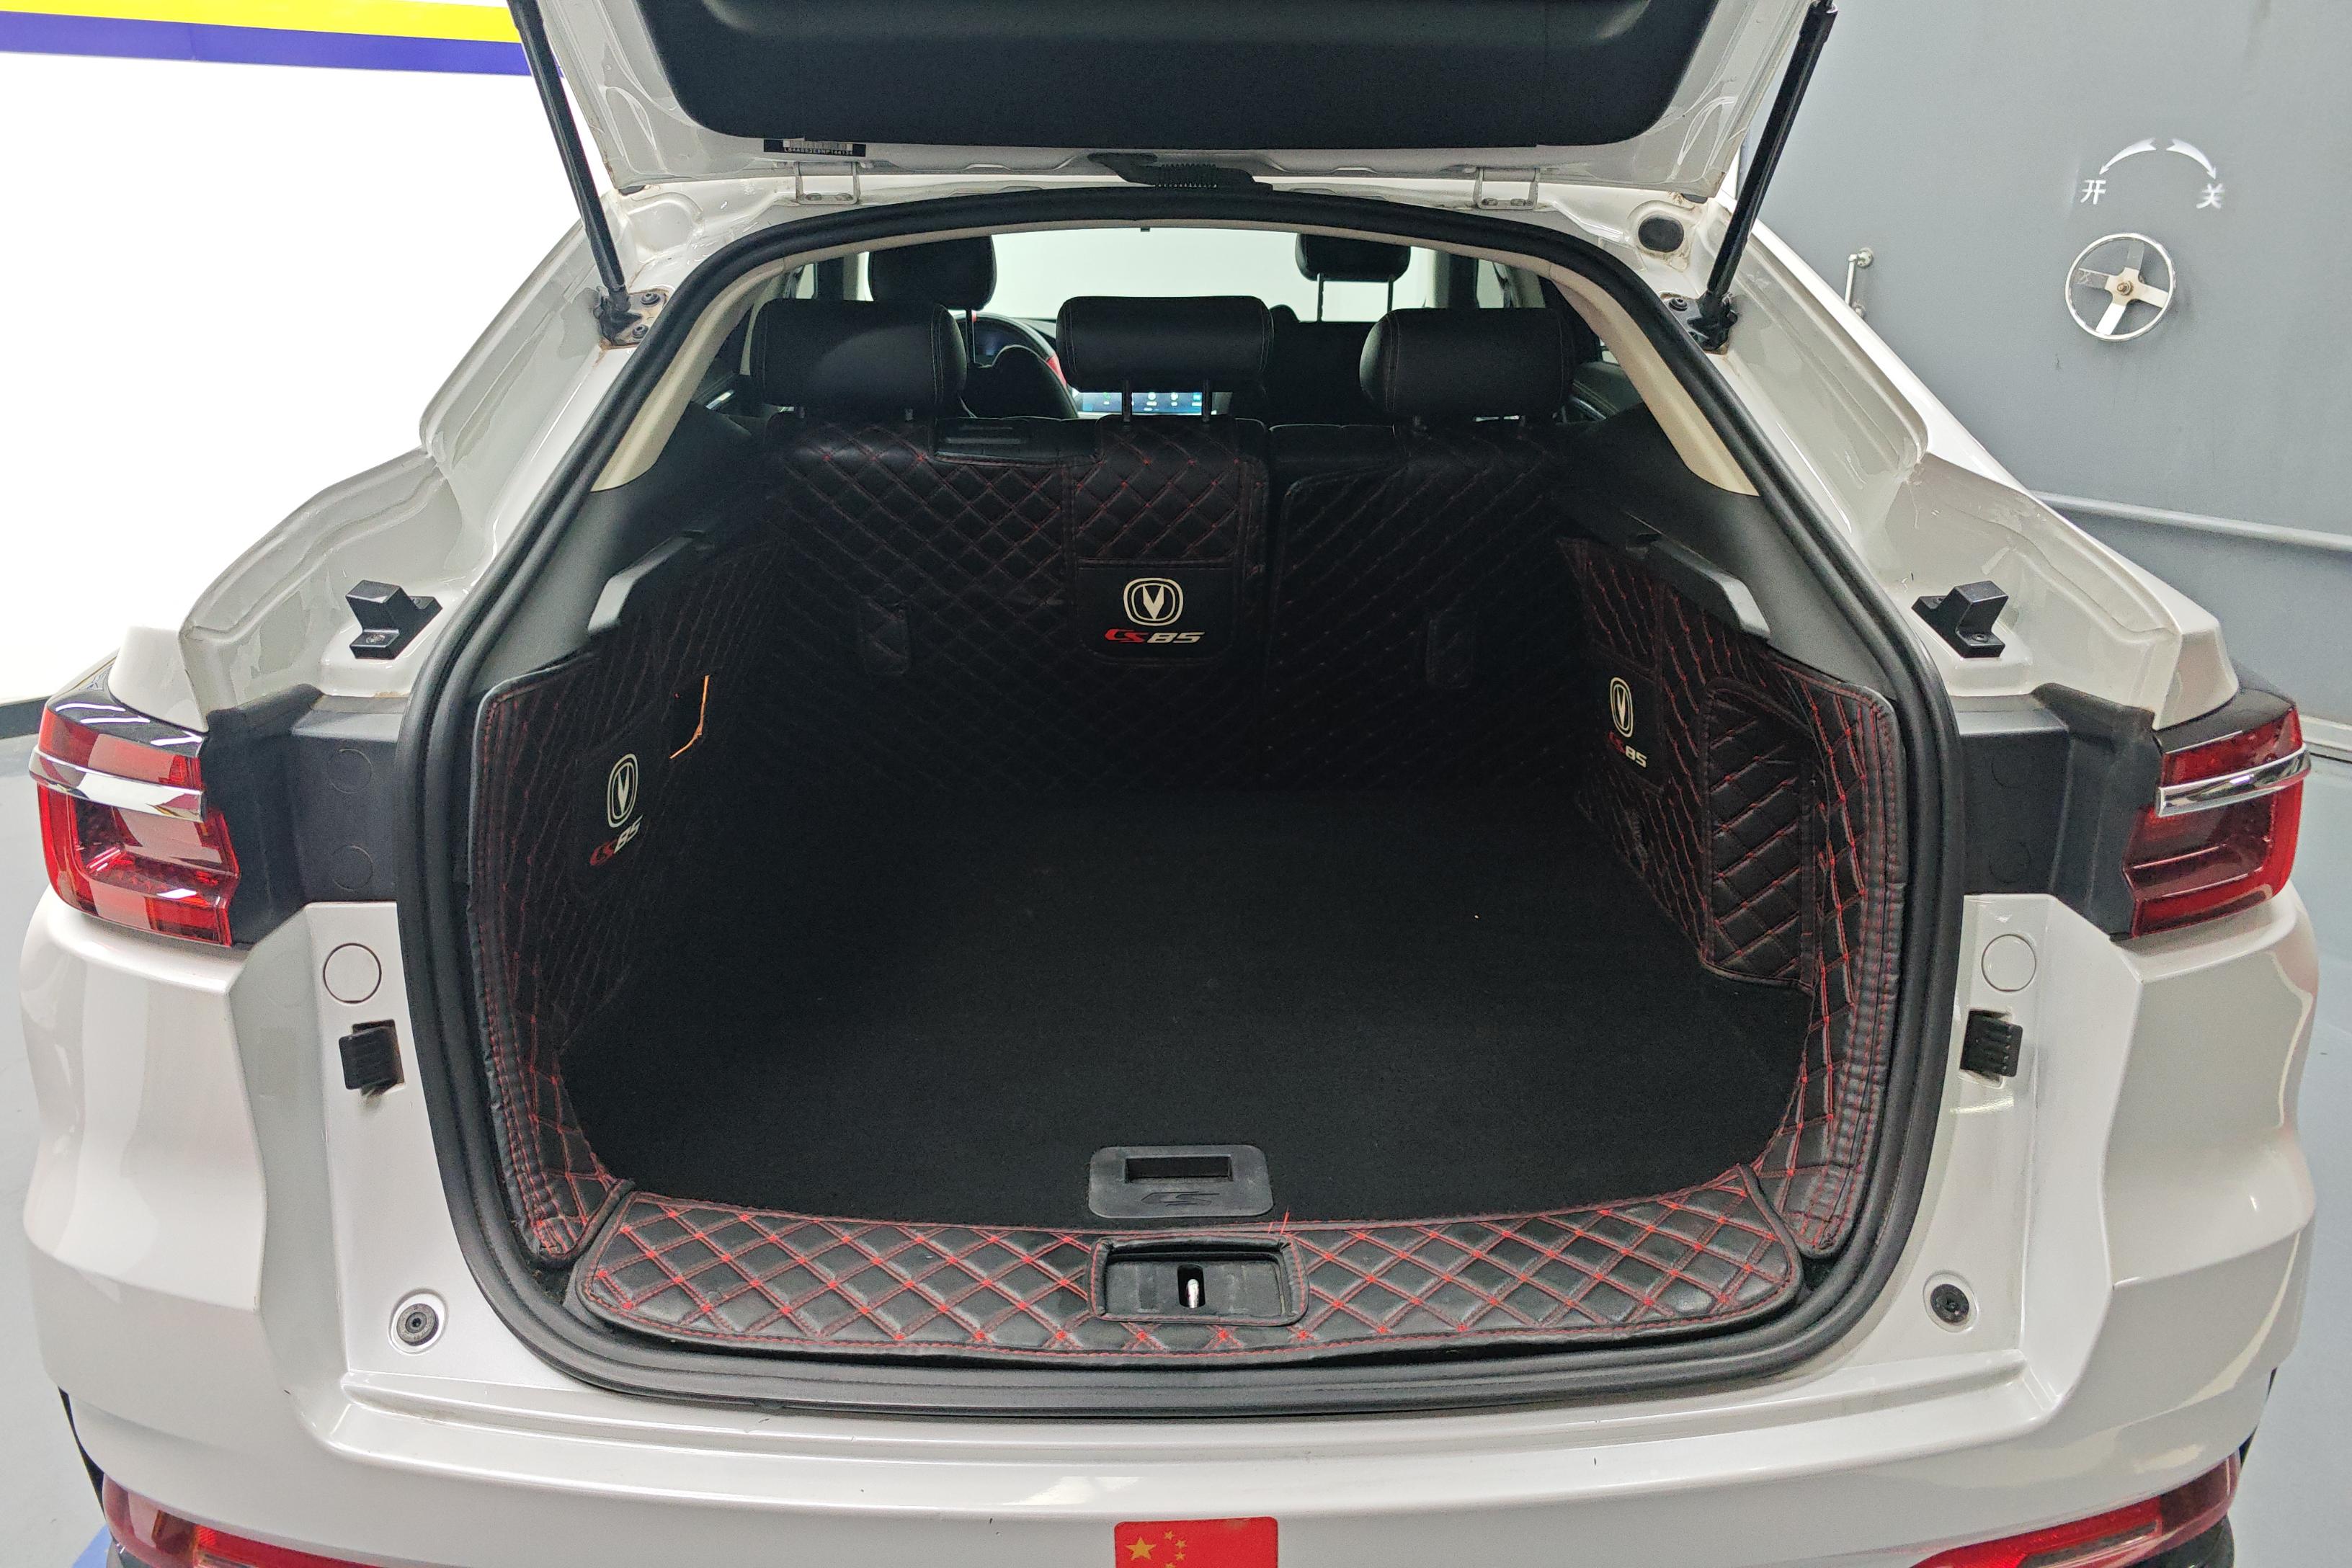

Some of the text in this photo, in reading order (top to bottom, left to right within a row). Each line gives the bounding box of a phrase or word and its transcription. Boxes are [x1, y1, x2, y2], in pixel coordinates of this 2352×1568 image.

[2080, 179, 2107, 205] 开
[2196, 182, 2225, 209] 关
[1104, 628, 1206, 644] CS85
